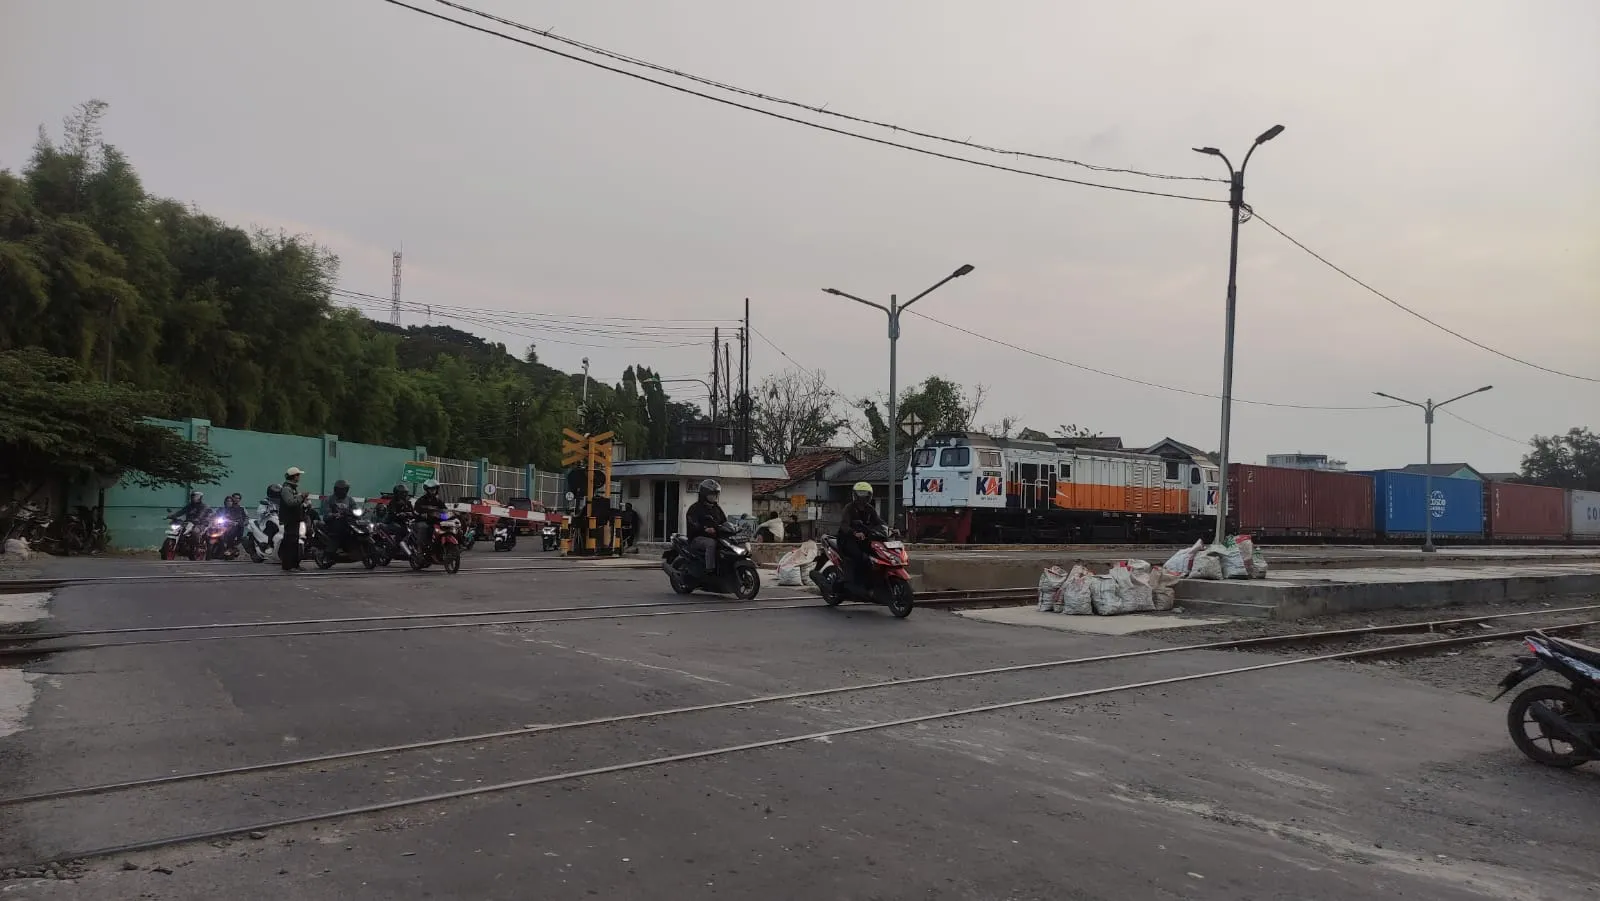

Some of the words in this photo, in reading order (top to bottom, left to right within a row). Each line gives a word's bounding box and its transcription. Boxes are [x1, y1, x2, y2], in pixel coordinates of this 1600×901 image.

[920, 478, 944, 492] KAI
[976, 476, 1003, 495] KAI
[1207, 490, 1219, 505] KA
[1587, 507, 1600, 520] CO
